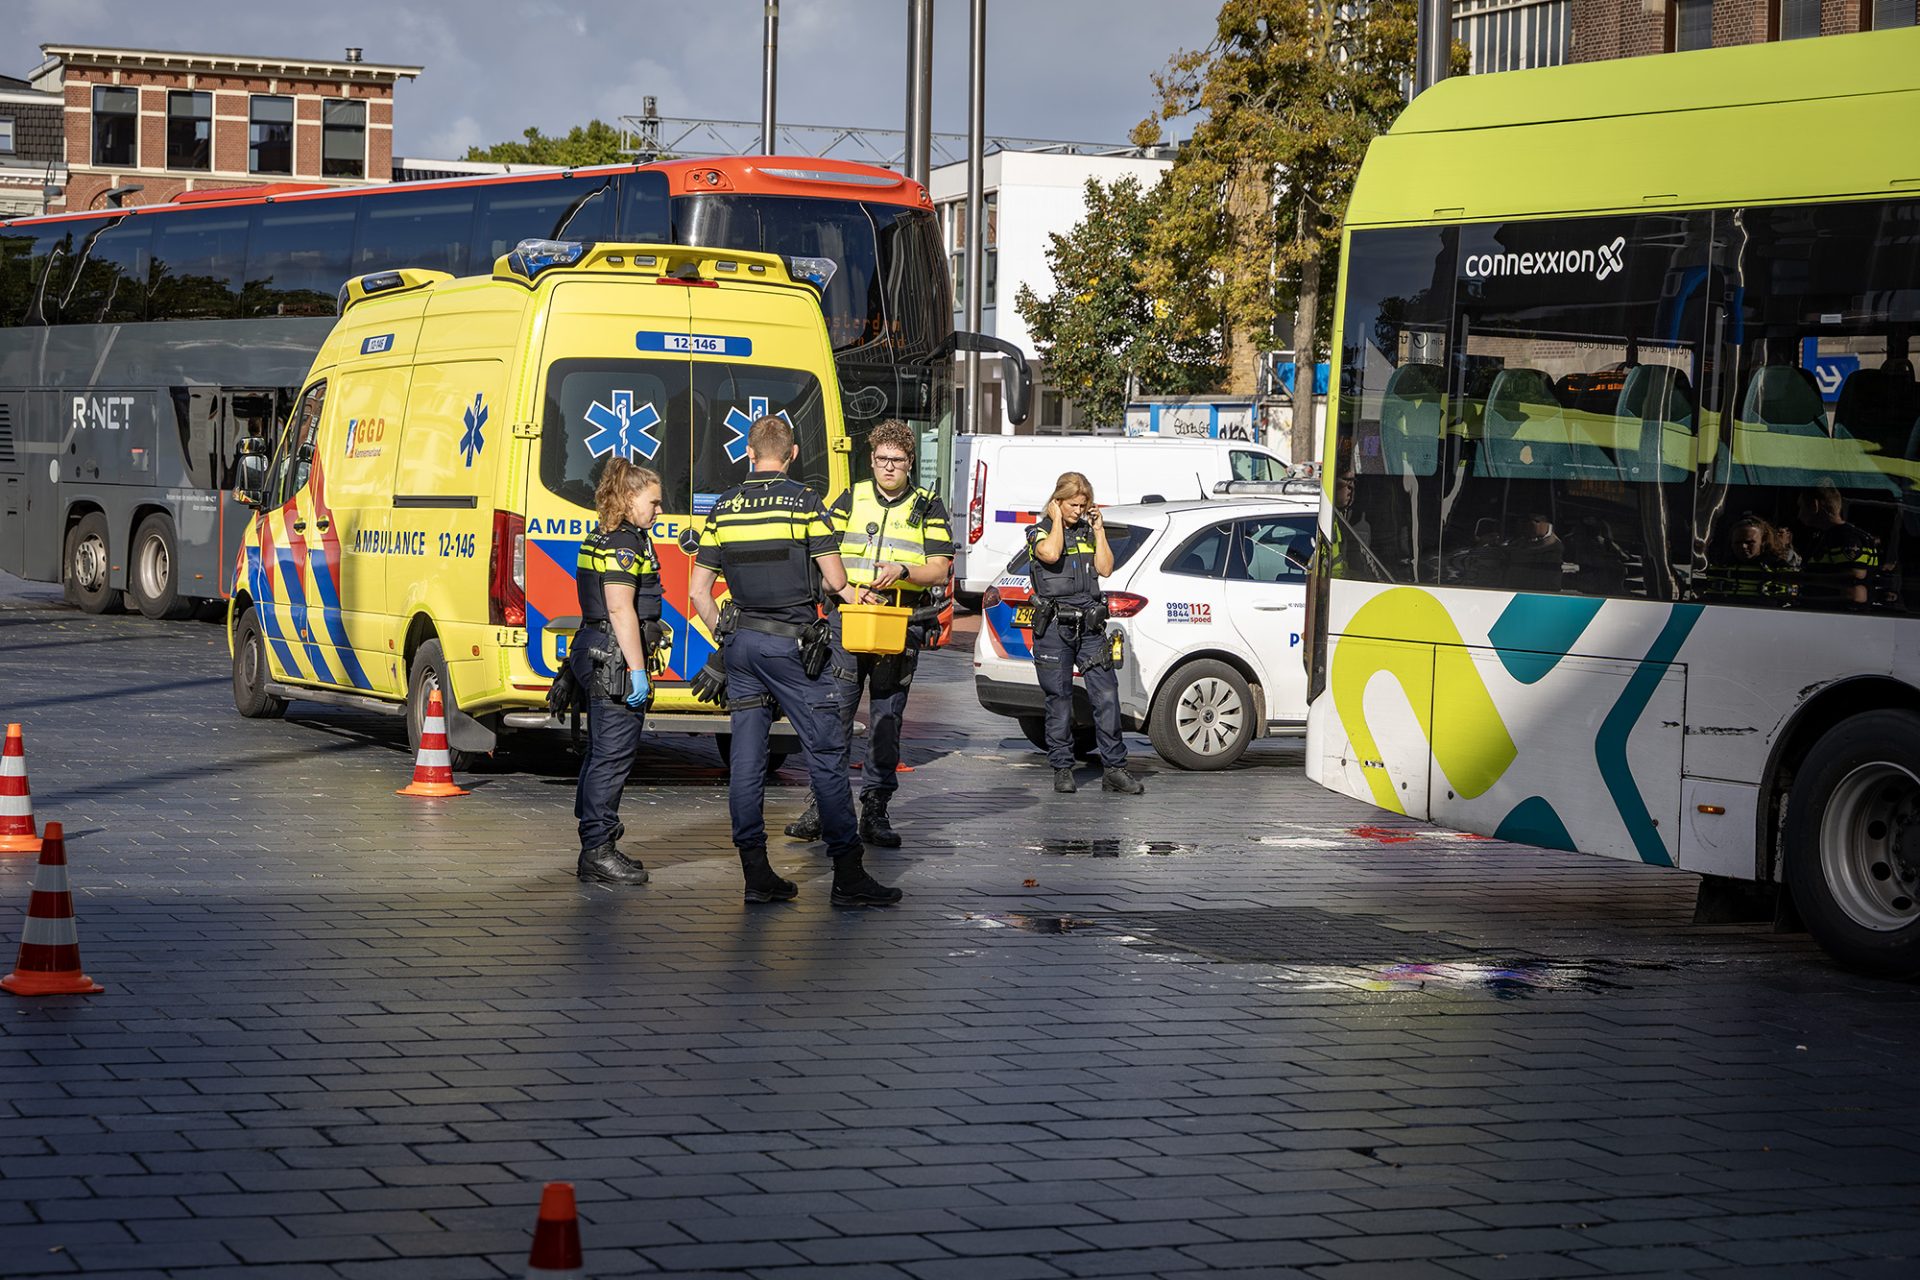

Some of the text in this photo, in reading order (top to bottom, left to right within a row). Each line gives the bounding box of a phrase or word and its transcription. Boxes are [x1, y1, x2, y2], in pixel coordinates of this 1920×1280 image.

[1465, 249, 1595, 277] connexxion
[673, 336, 717, 350] 12-146
[357, 418, 385, 443] GGD
[527, 518, 679, 539] AMBUCE
[353, 530, 426, 555] AMBULANCE
[438, 532, 476, 558] 12-146
[998, 577, 1027, 586] POLITIE
[1166, 602, 1189, 610] 0900
[1189, 603, 1211, 616] 112
[1190, 616, 1212, 624] spoed
